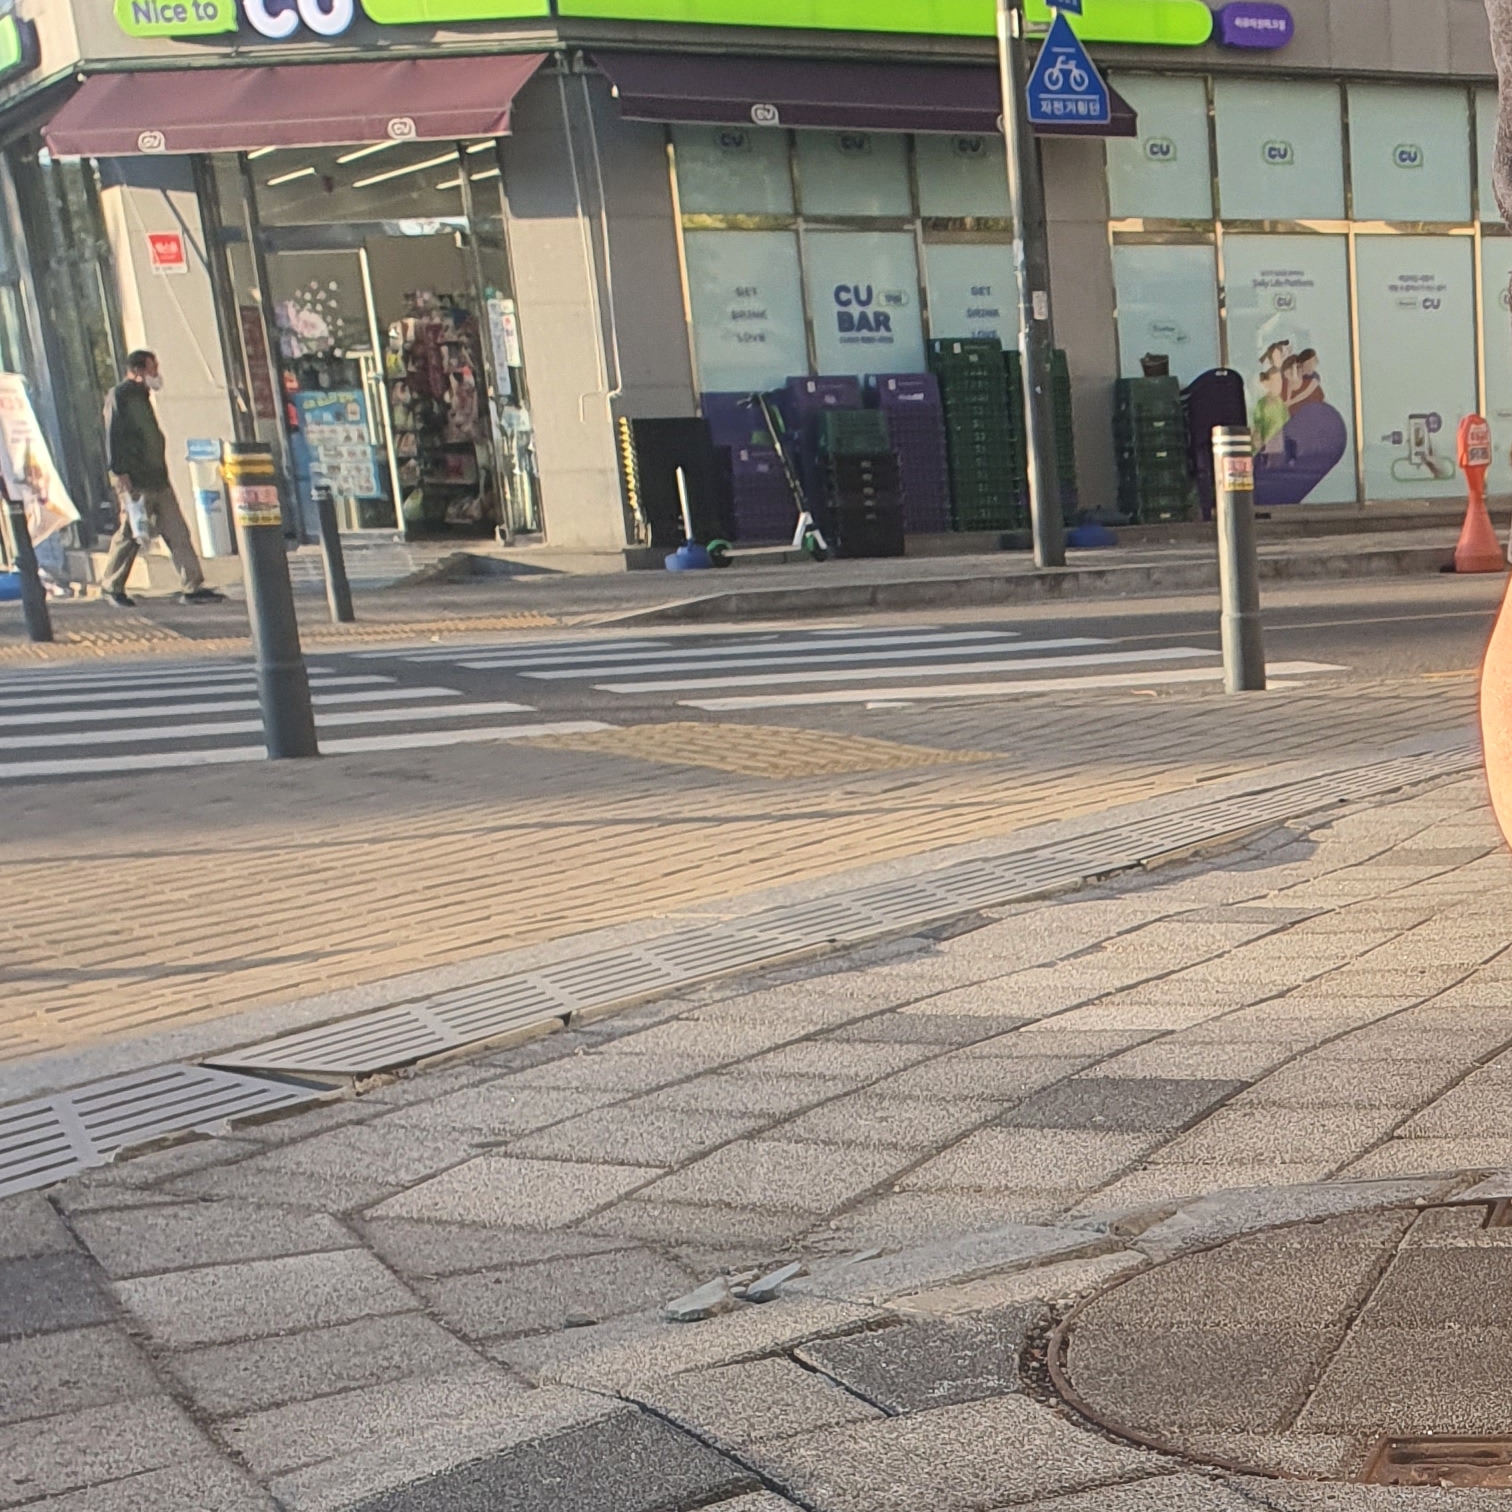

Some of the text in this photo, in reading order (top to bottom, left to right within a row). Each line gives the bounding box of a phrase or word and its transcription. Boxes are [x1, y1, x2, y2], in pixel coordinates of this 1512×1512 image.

[132, 0, 219, 25] Nice to
[243, 0, 354, 38] CU
[720, 132, 743, 147] CU
[841, 136, 864, 149] CU
[958, 139, 980, 152] CU
[1149, 143, 1170, 156] CU
[1267, 146, 1288, 159] CU
[1398, 149, 1418, 162] CU
[834, 284, 873, 308] CU
[1276, 297, 1292, 308] CU
[1422, 298, 1441, 310] CU
[836, 311, 893, 333] BAR
